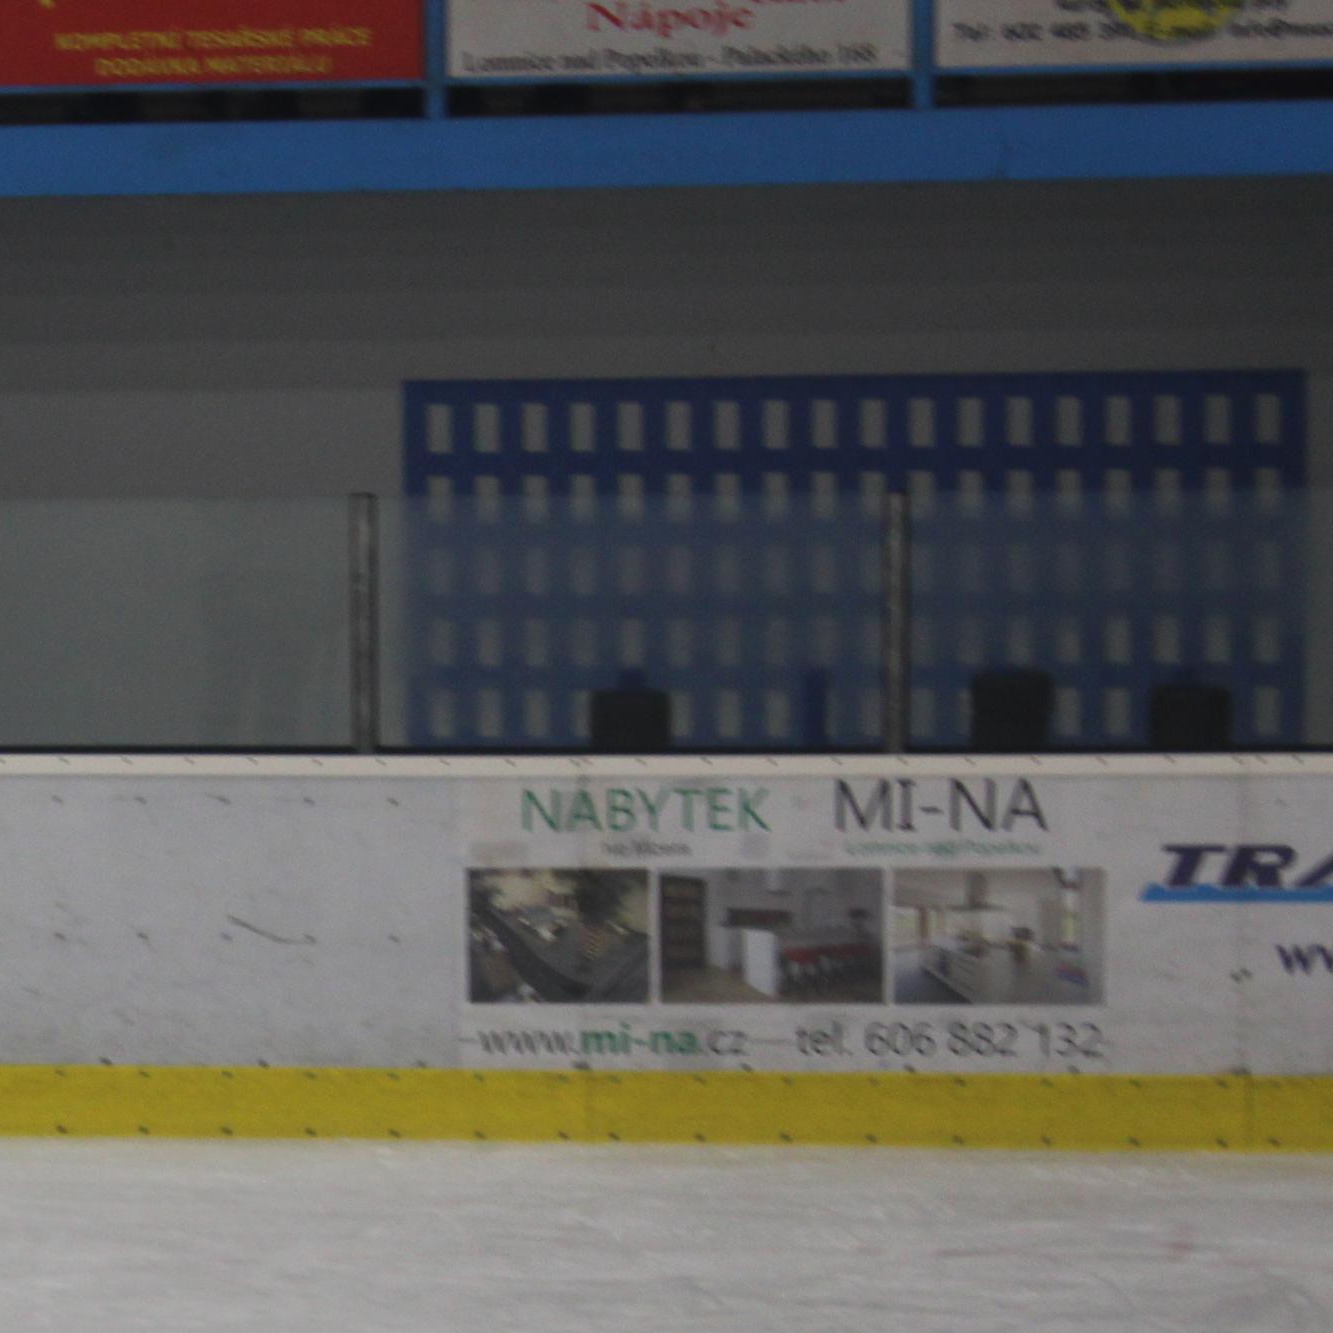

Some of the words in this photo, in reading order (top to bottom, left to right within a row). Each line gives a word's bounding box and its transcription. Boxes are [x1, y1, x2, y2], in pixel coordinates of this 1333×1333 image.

[833, 777, 1049, 832] MI-NA
[477, 1019, 750, 1056] www.mi-na.cz
[864, 1021, 938, 1057] 606
[946, 1021, 1017, 1057] 882
